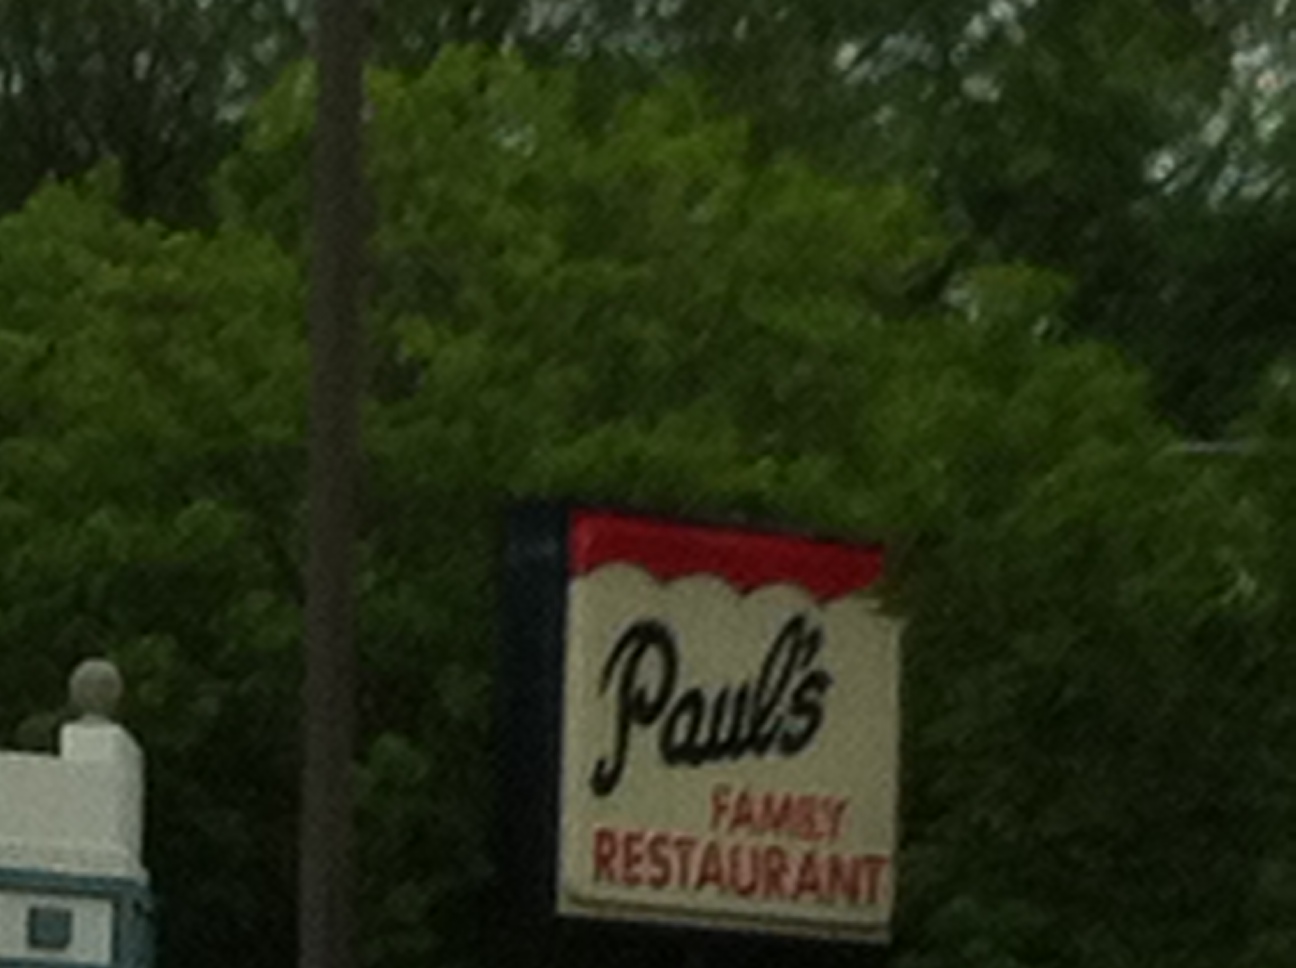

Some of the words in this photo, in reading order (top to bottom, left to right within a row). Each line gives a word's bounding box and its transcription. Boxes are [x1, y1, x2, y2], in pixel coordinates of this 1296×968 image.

[589, 612, 833, 796] Paul's
[710, 786, 848, 842] FAMILY
[593, 827, 889, 906] RESTAURANT
